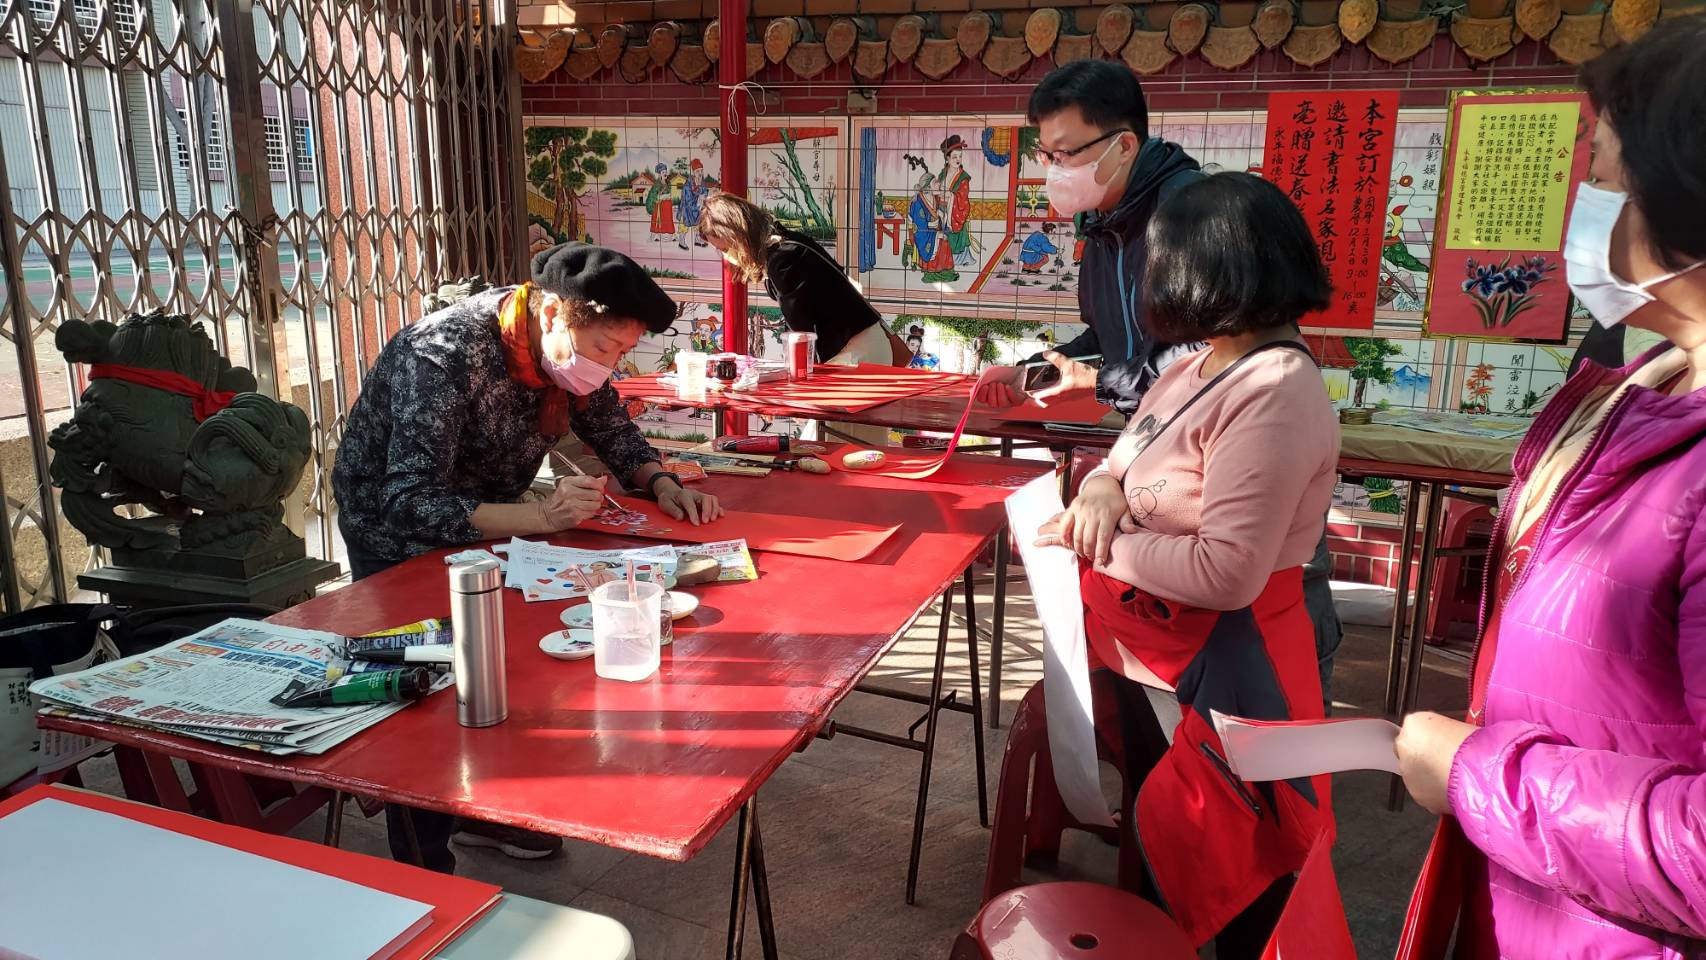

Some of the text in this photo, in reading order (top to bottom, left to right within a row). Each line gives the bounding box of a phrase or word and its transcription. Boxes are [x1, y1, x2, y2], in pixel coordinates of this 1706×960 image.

[1288, 100, 1317, 213] 毫贈送春
[1317, 100, 1350, 285] 邀請書法名家現
[1354, 98, 1386, 194] 本宮訂於
[1553, 147, 1569, 183] 公告
